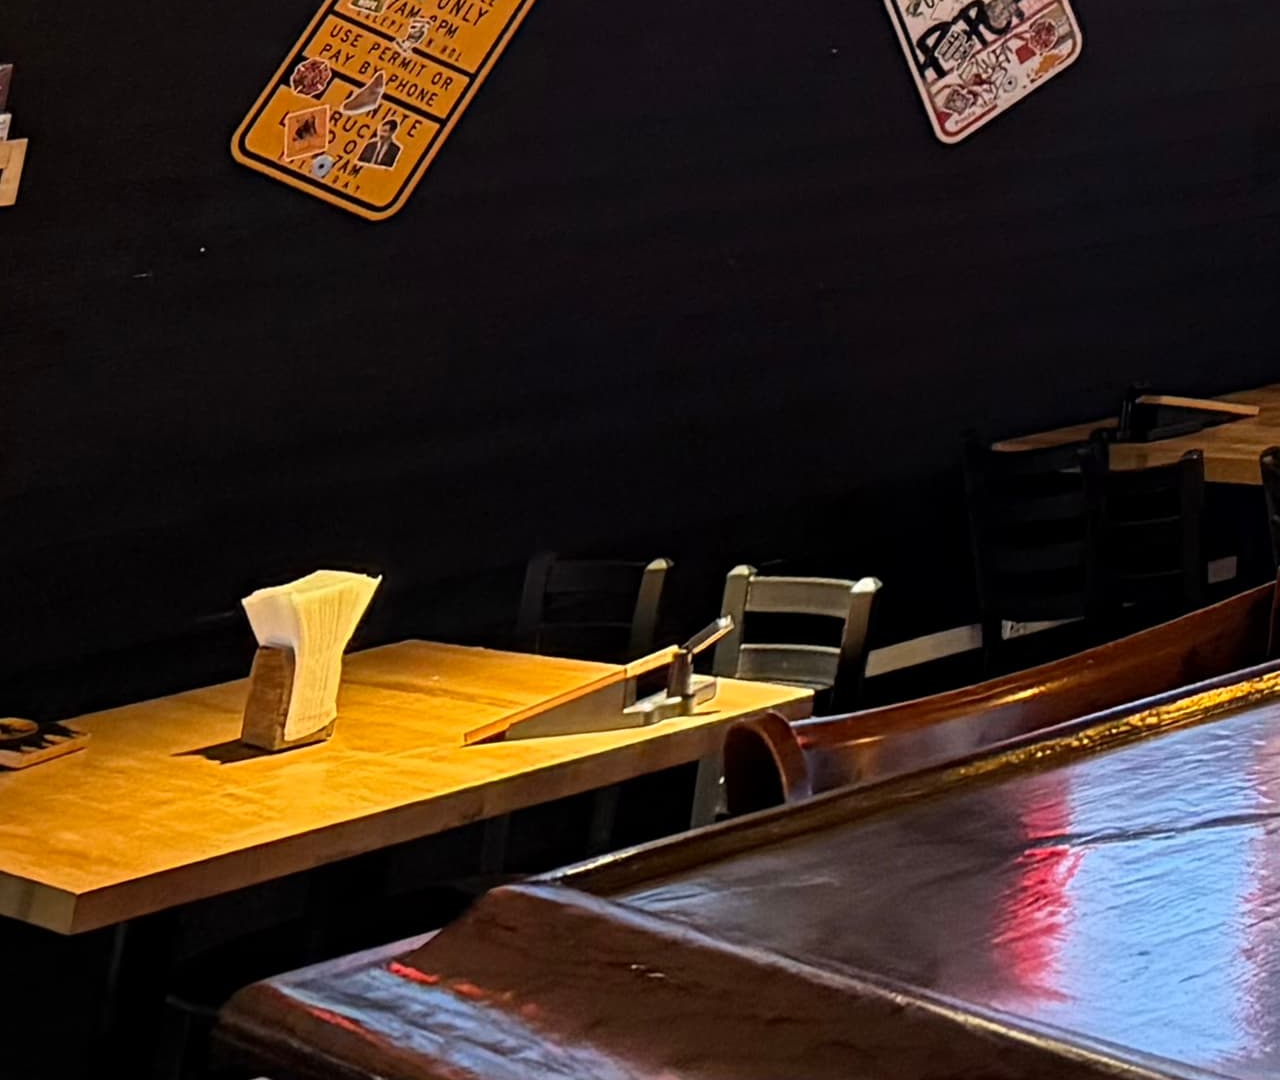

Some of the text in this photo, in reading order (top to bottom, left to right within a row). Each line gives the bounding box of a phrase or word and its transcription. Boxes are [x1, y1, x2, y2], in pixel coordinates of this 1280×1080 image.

[319, 42, 355, 69] PAY
[385, 73, 439, 108] PHONE
[328, 24, 454, 92] USE PERMIT OR
